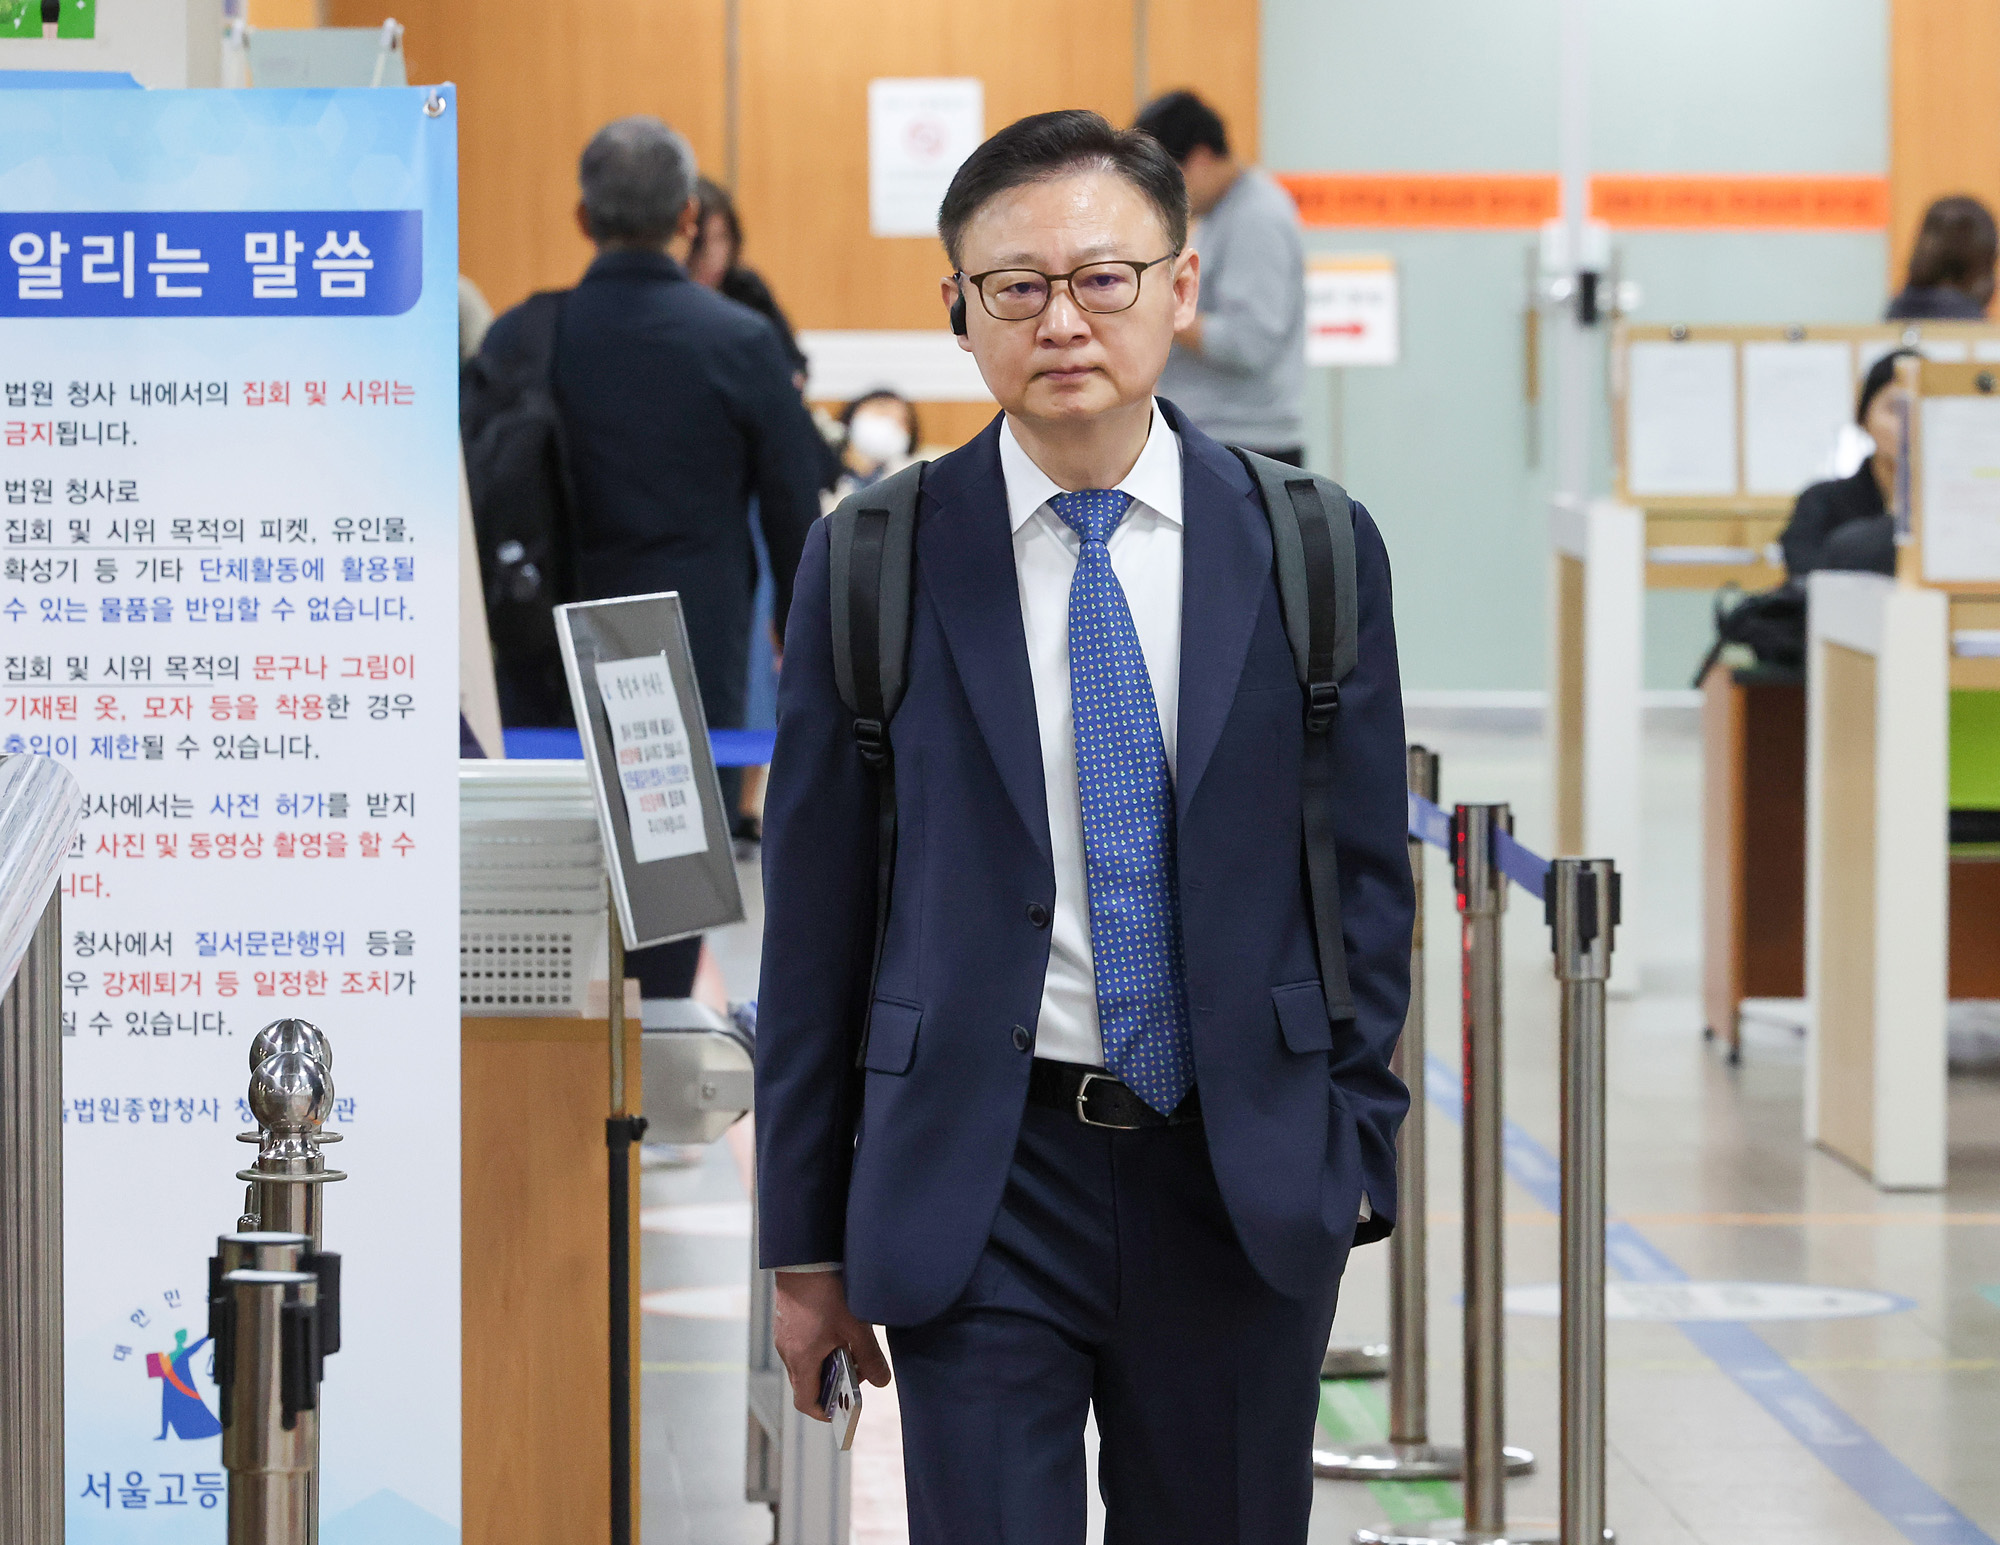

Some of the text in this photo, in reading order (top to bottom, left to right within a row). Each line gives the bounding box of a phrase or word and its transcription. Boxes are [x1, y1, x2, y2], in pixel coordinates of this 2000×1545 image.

[9, 230, 374, 299] 알리는 말씀
[5, 380, 416, 408] 법원 청사 내에서의 집회 및 시위는
[4, 420, 138, 447] 금지됩니다.
[4, 478, 140, 505] 법원 청사로
[5, 516, 414, 544] 집회 및 시위 목적의 피켓, 유인물,
[3, 556, 414, 584] 확성기 등 기타 단체활동에 활용될
[3, 595, 415, 623] 수 있는 물품을 반입할 수 없습니다.
[4, 654, 414, 682] 집회 및 시위 목적의 문구나 그림이
[5, 693, 416, 721] 기재된 옷, 모자 등을 착용한 경우
[90, 734, 164, 761] 제한될
[176, 734, 200, 761] 수
[212, 733, 320, 761] 있습니다.
[210, 793, 259, 819] 사전
[275, 792, 350, 819] 허가를
[366, 792, 415, 818] 받지
[95, 833, 145, 859] 사진
[155, 832, 178, 859] 및
[188, 832, 265, 859] 동영상
[273, 831, 348, 859] 촬영을
[359, 831, 383, 858] 할
[391, 831, 416, 857] 수
[73, 929, 416, 958] 청사에서 질서문란행위 등을
[103, 970, 202, 998] 강제퇴거
[215, 971, 240, 998] 등
[253, 970, 329, 997] 일정한
[340, 969, 417, 996] 조치가
[88, 1010, 113, 1037] 수
[125, 1010, 233, 1037] 있습니다.
[63, 1097, 220, 1123] 법원종합청사
